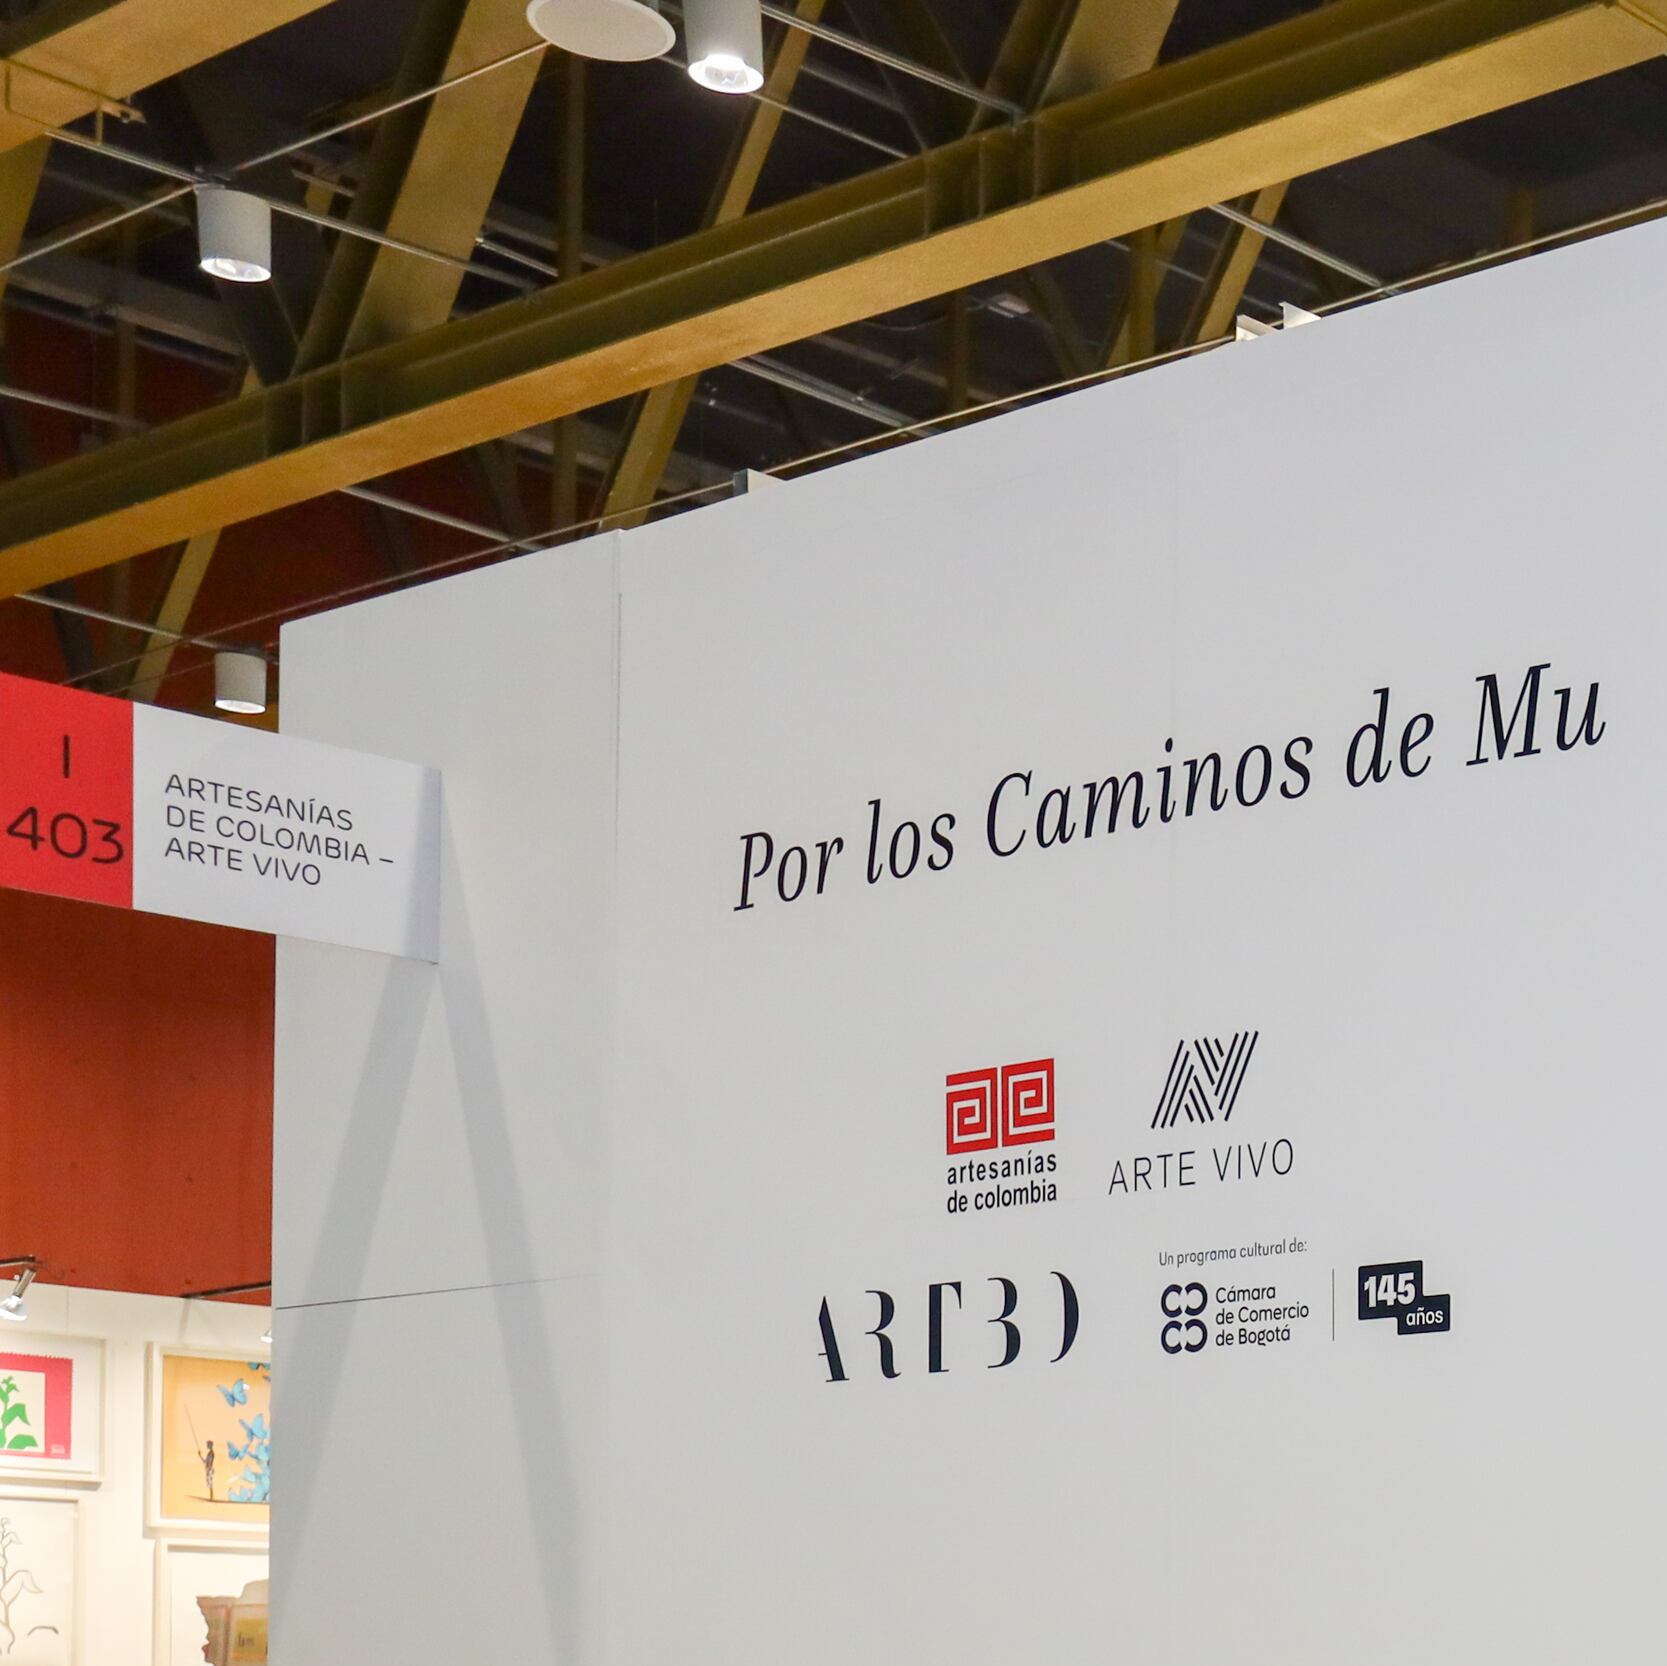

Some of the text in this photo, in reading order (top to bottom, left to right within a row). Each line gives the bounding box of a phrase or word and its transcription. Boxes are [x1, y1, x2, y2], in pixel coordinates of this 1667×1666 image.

[165, 773, 353, 830] ARTESANÍAS
[733, 662, 1607, 911] Por los Caminos de Mu
[7, 806, 124, 864] 403
[166, 806, 206, 831] DE
[216, 815, 369, 864] COLOMBIA
[165, 837, 321, 886] ARTE VIVO
[947, 1151, 1057, 1184] artesanías
[1108, 1139, 1294, 1195] ARTE VIVO
[947, 1179, 1057, 1214] de colombia
[1159, 1237, 1307, 1268] Un programa cultural de:
[1216, 1286, 1276, 1304] Cámara
[1364, 1272, 1416, 1308] 145
[1216, 1302, 1309, 1324] de Comercio
[1405, 1307, 1443, 1326] años
[1216, 1325, 1290, 1346] de Bogotá
